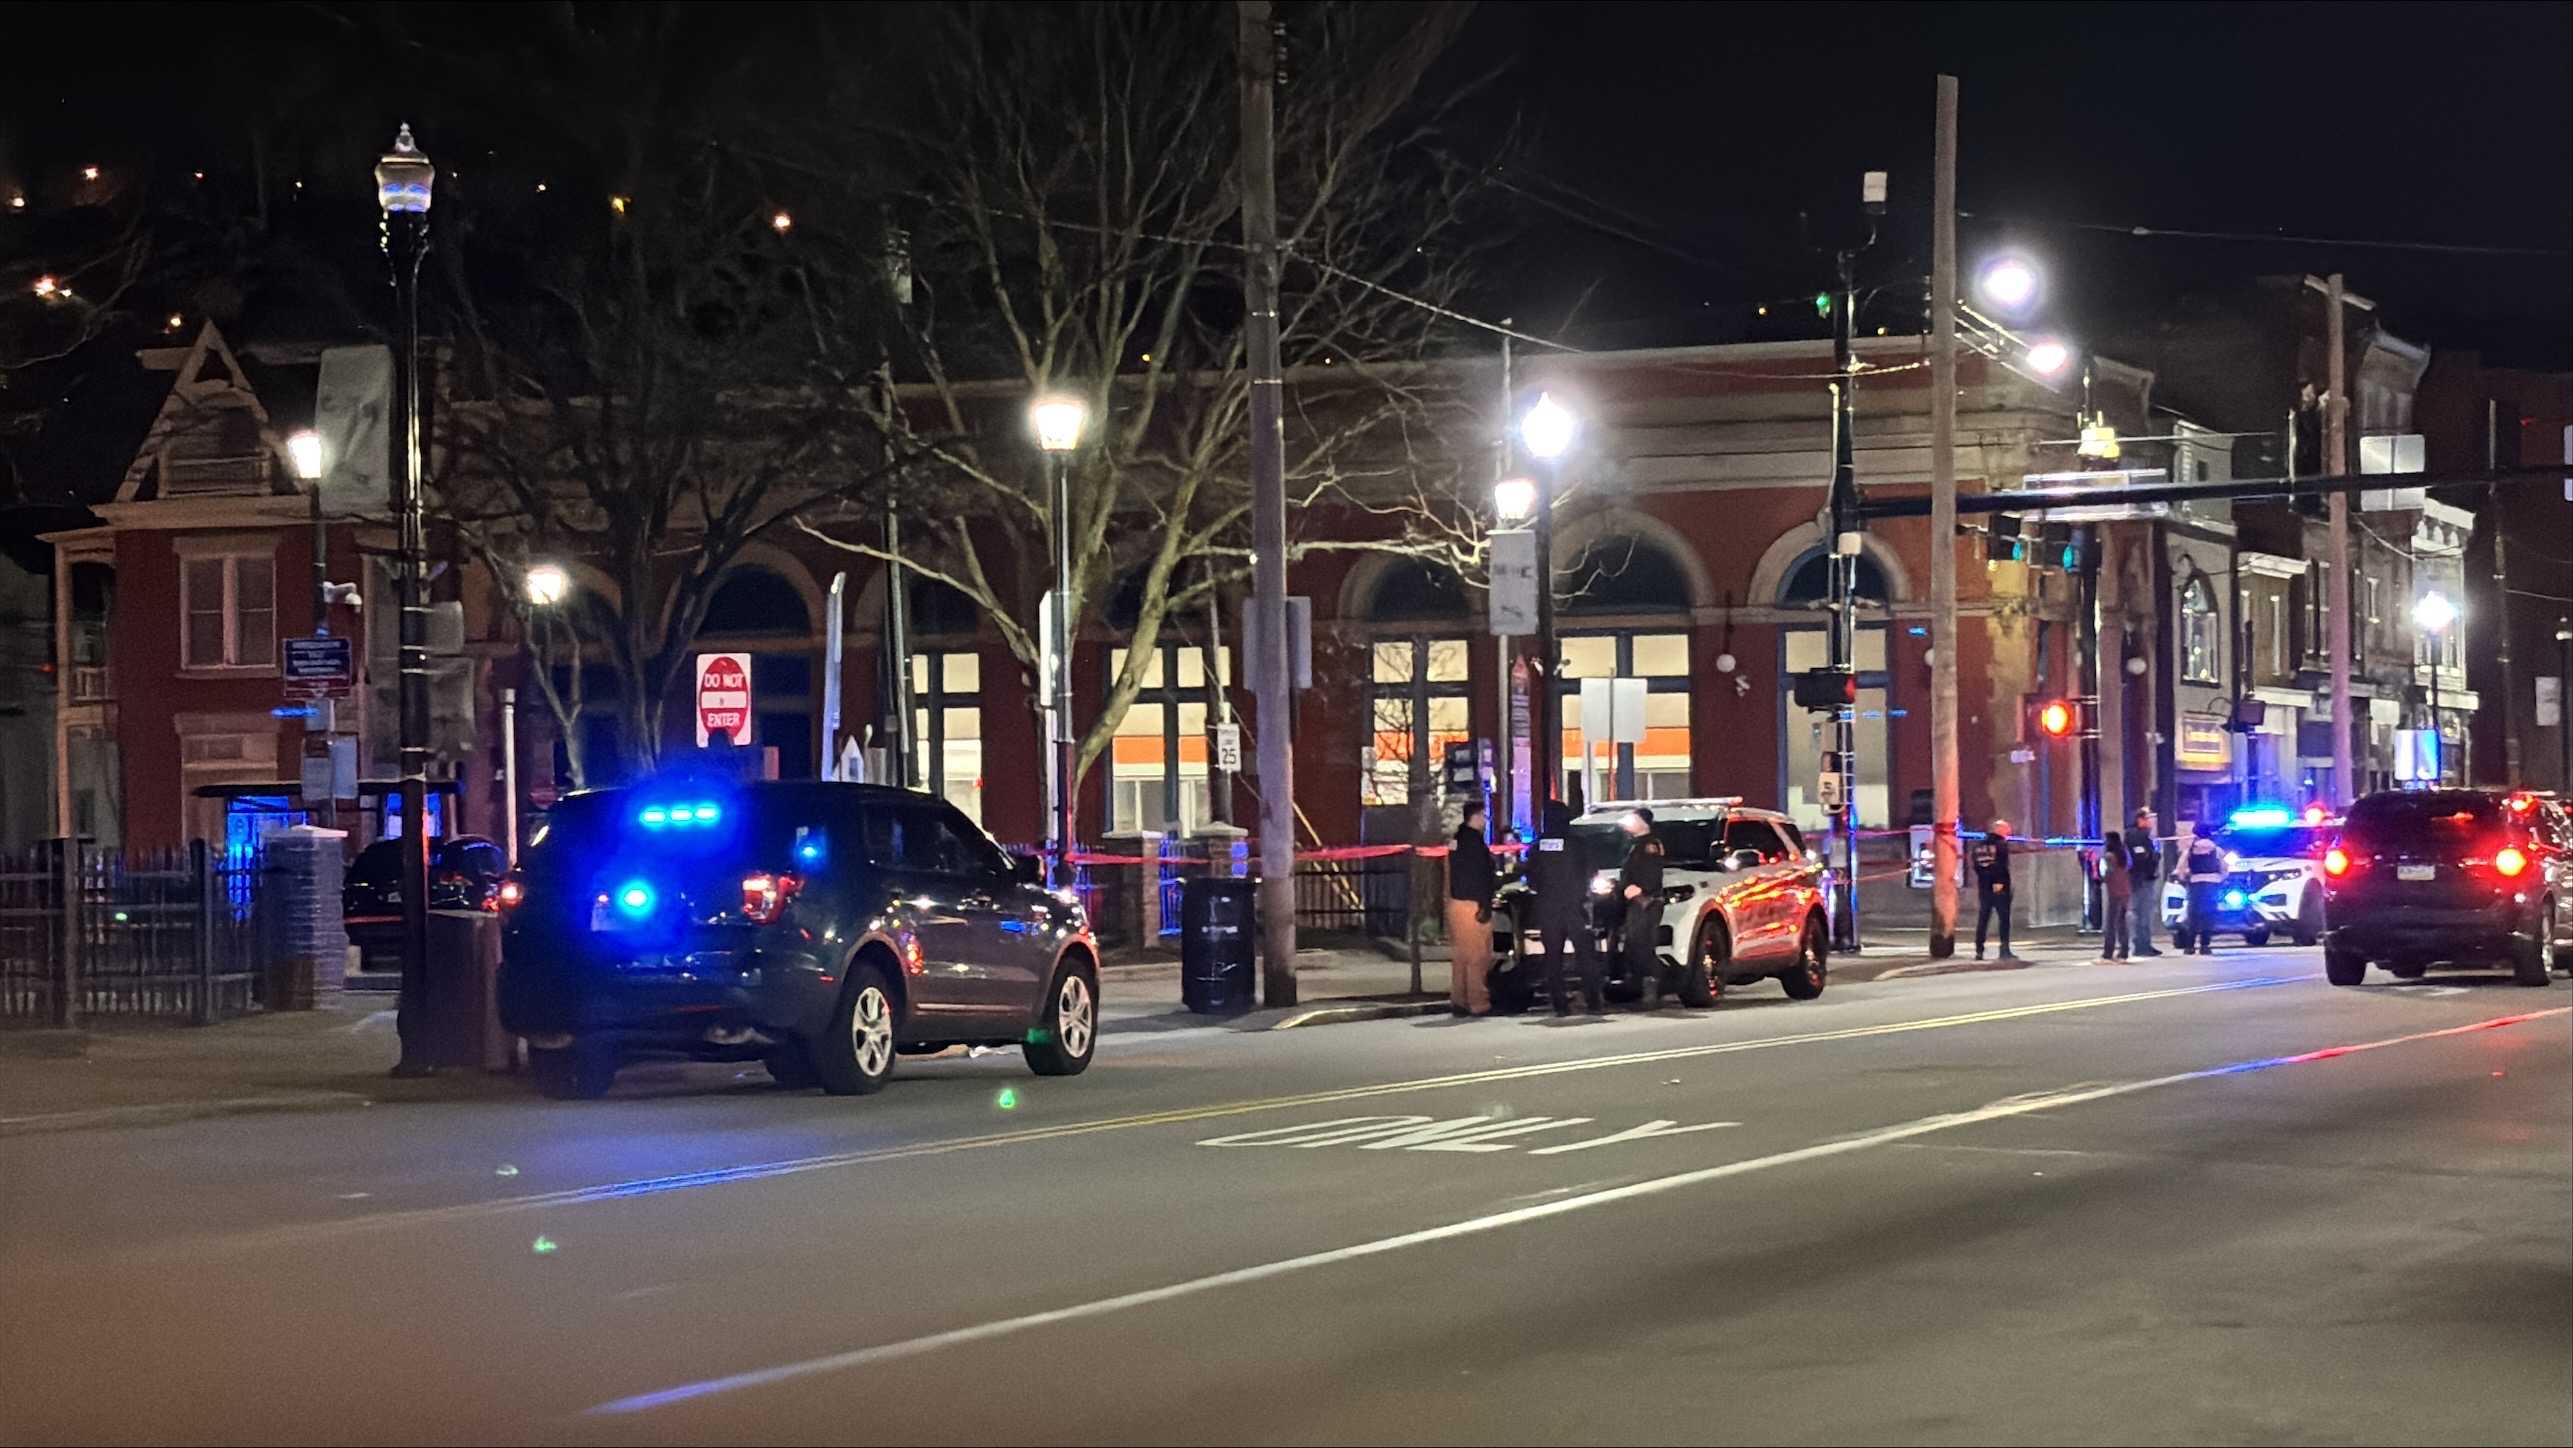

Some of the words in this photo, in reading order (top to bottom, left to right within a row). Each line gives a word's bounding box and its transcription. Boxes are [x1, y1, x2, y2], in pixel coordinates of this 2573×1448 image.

[704, 673, 720, 688] DO
[723, 673, 744, 688] NOT
[707, 713, 740, 728] ENTER
[1222, 748, 1237, 765] 25
[1195, 1116, 1743, 1155] ONLY
